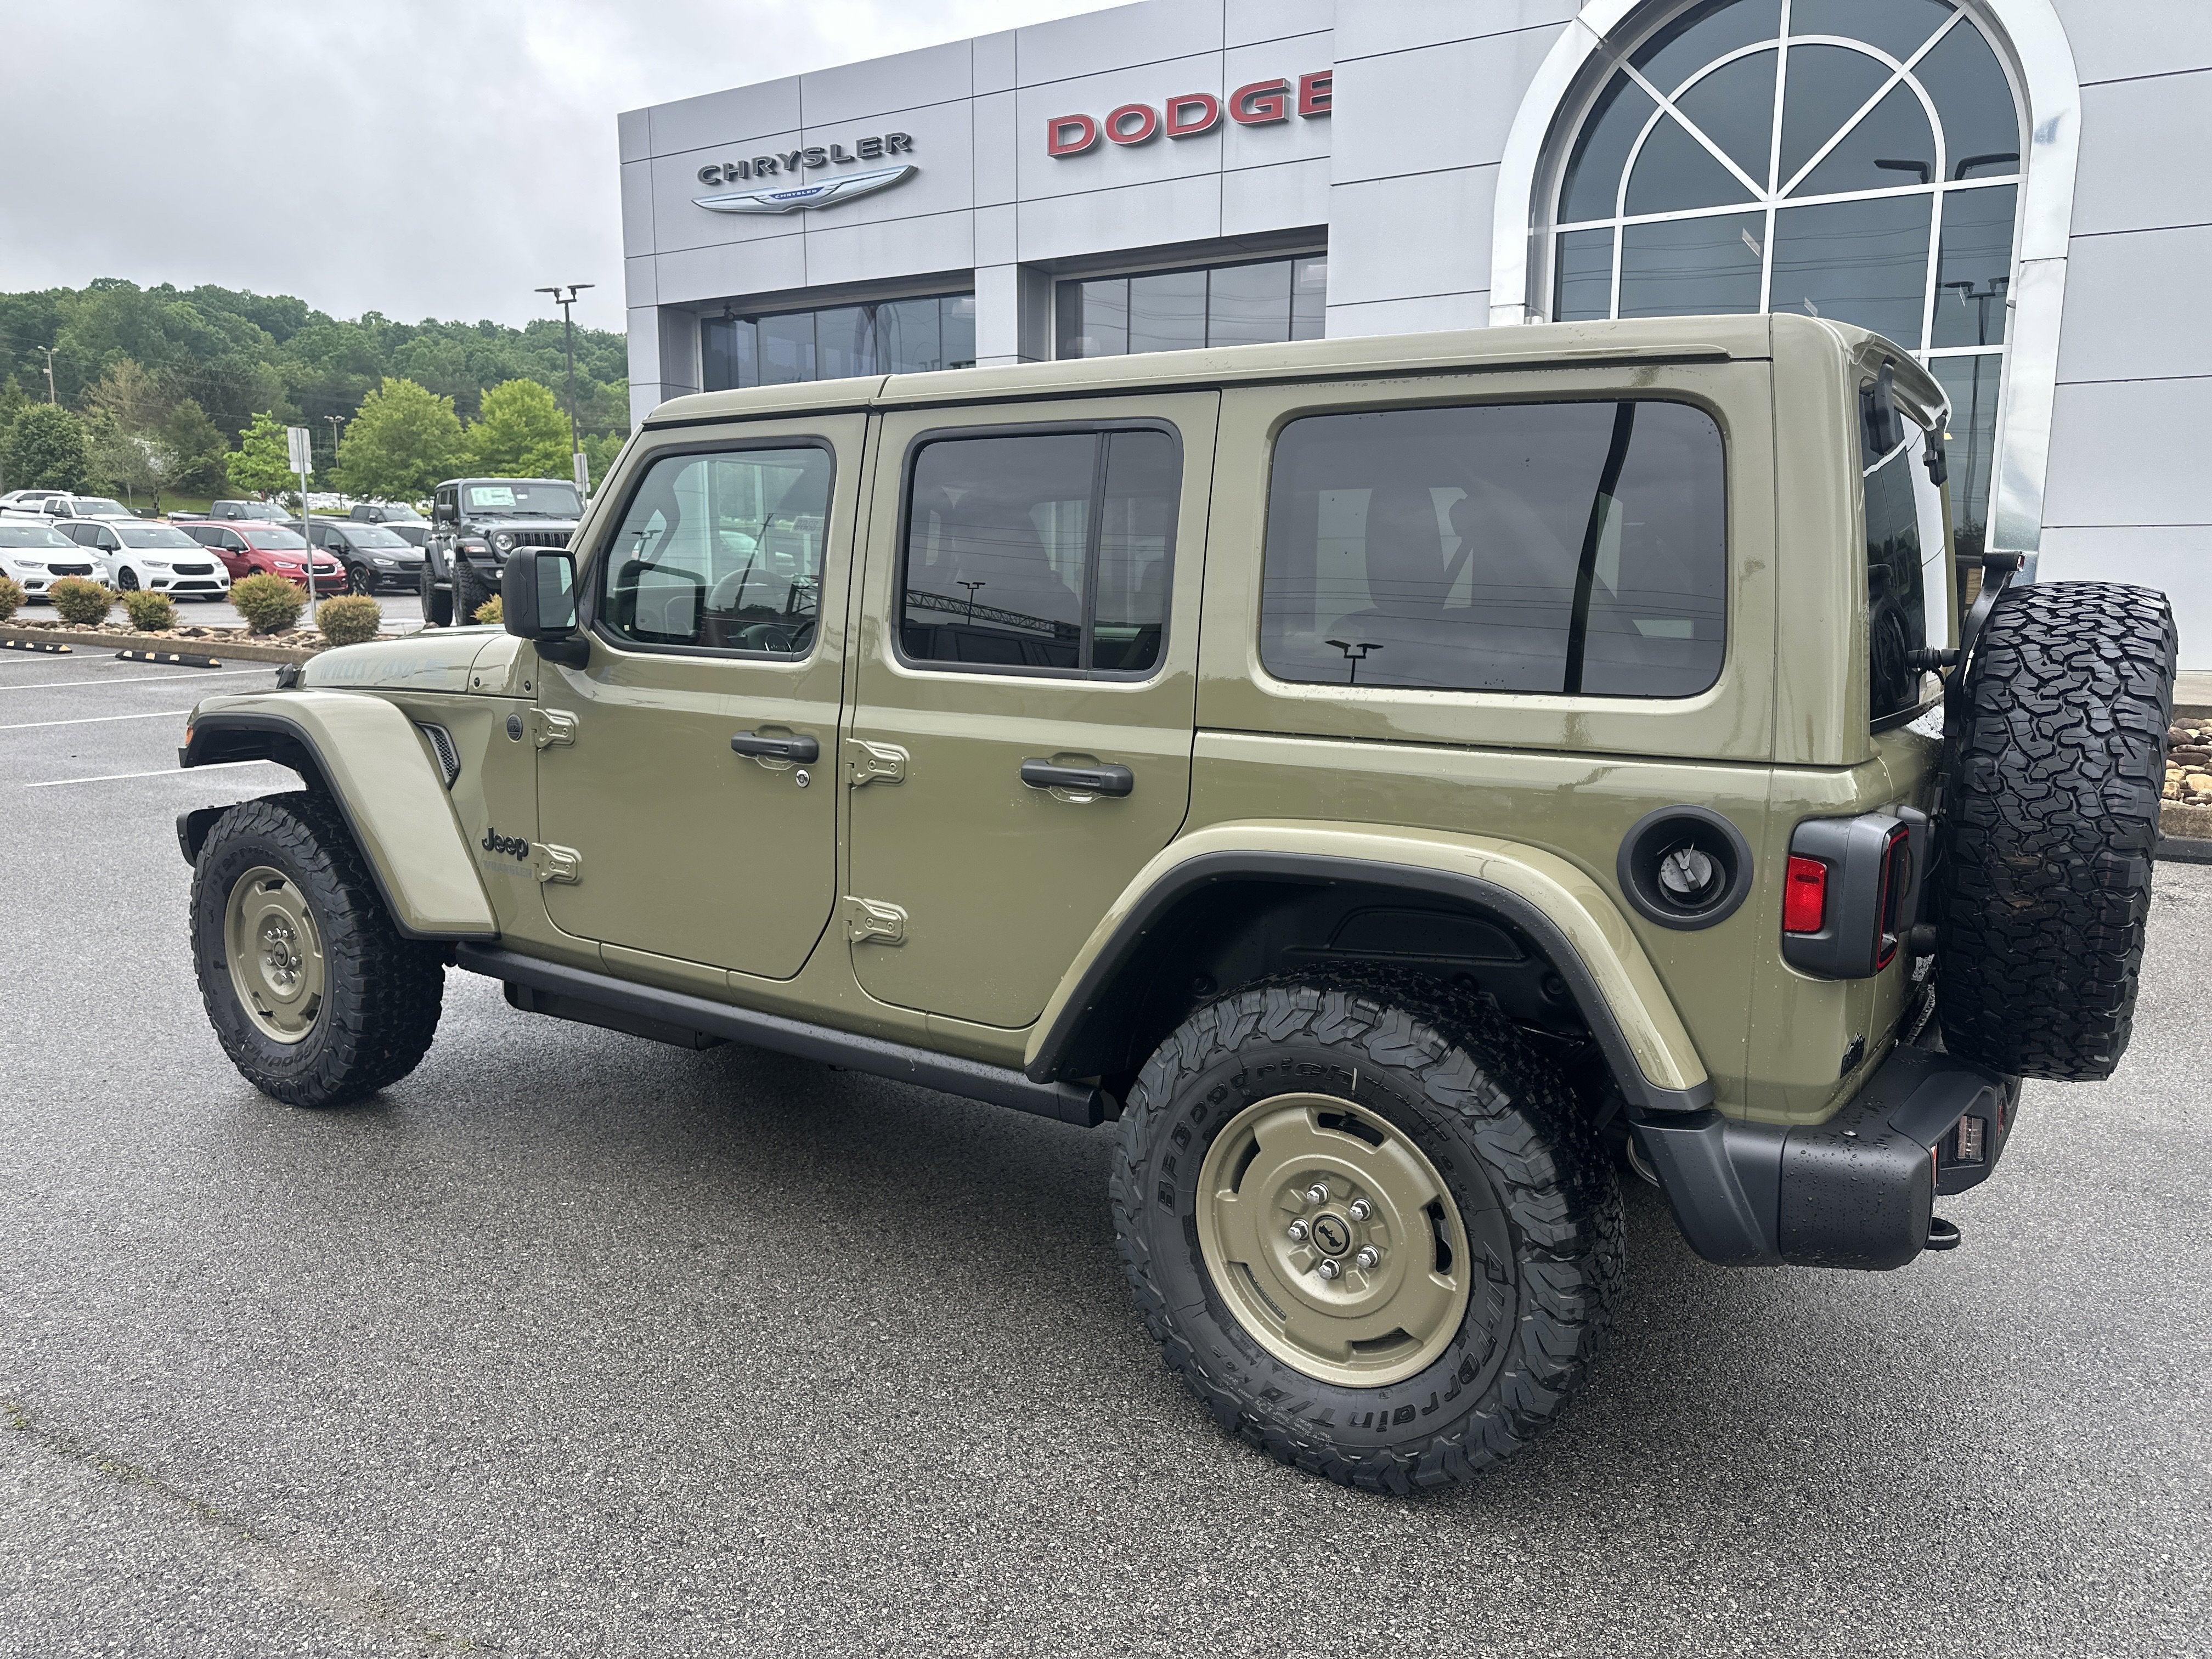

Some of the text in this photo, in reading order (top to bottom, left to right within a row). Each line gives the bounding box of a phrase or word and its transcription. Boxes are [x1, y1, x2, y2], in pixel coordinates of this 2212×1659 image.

[1047, 70, 1333, 158] DODGE
[697, 132, 913, 184] CHRYSLER
[775, 188, 817, 199] CHRYSLER
[481, 826, 529, 861] Jeep
[1158, 1057, 1354, 1217] BFGoodrich
